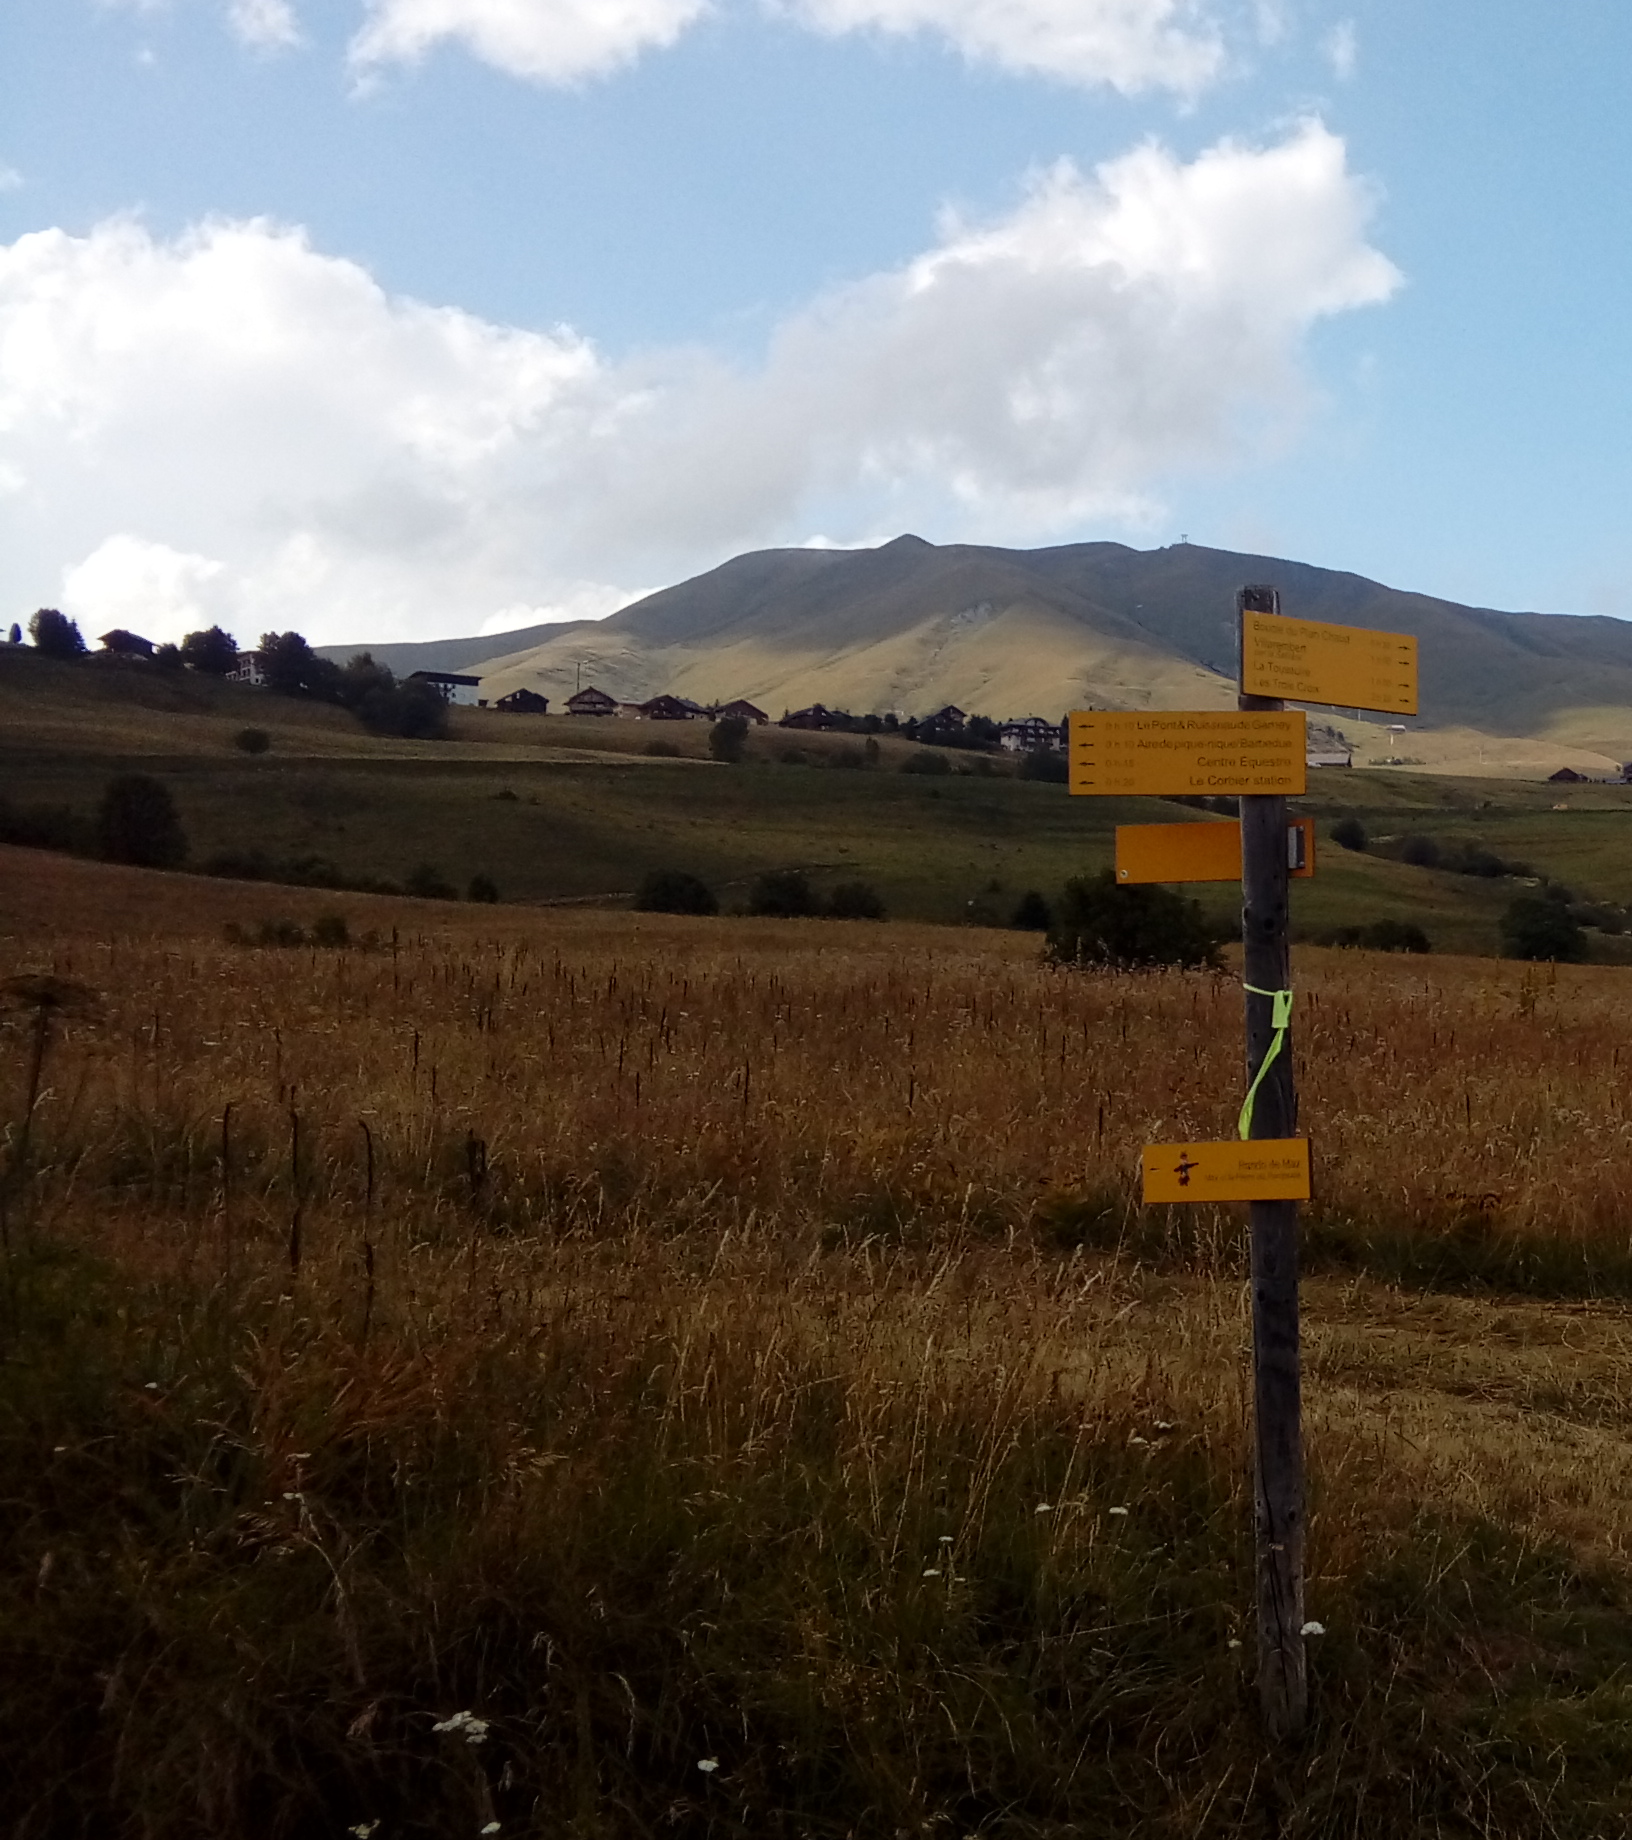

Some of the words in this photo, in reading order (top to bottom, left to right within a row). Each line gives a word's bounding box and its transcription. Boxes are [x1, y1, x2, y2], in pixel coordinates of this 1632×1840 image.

[1254, 659, 1265, 672] La
[1137, 721, 1150, 730] Le
[1152, 720, 1176, 730] Pont
[1159, 739, 1172, 749] de
[1197, 756, 1236, 767] Centre
[1189, 776, 1204, 786] Le
[1207, 775, 1249, 786] Corbier
[1253, 775, 1292, 785] station
